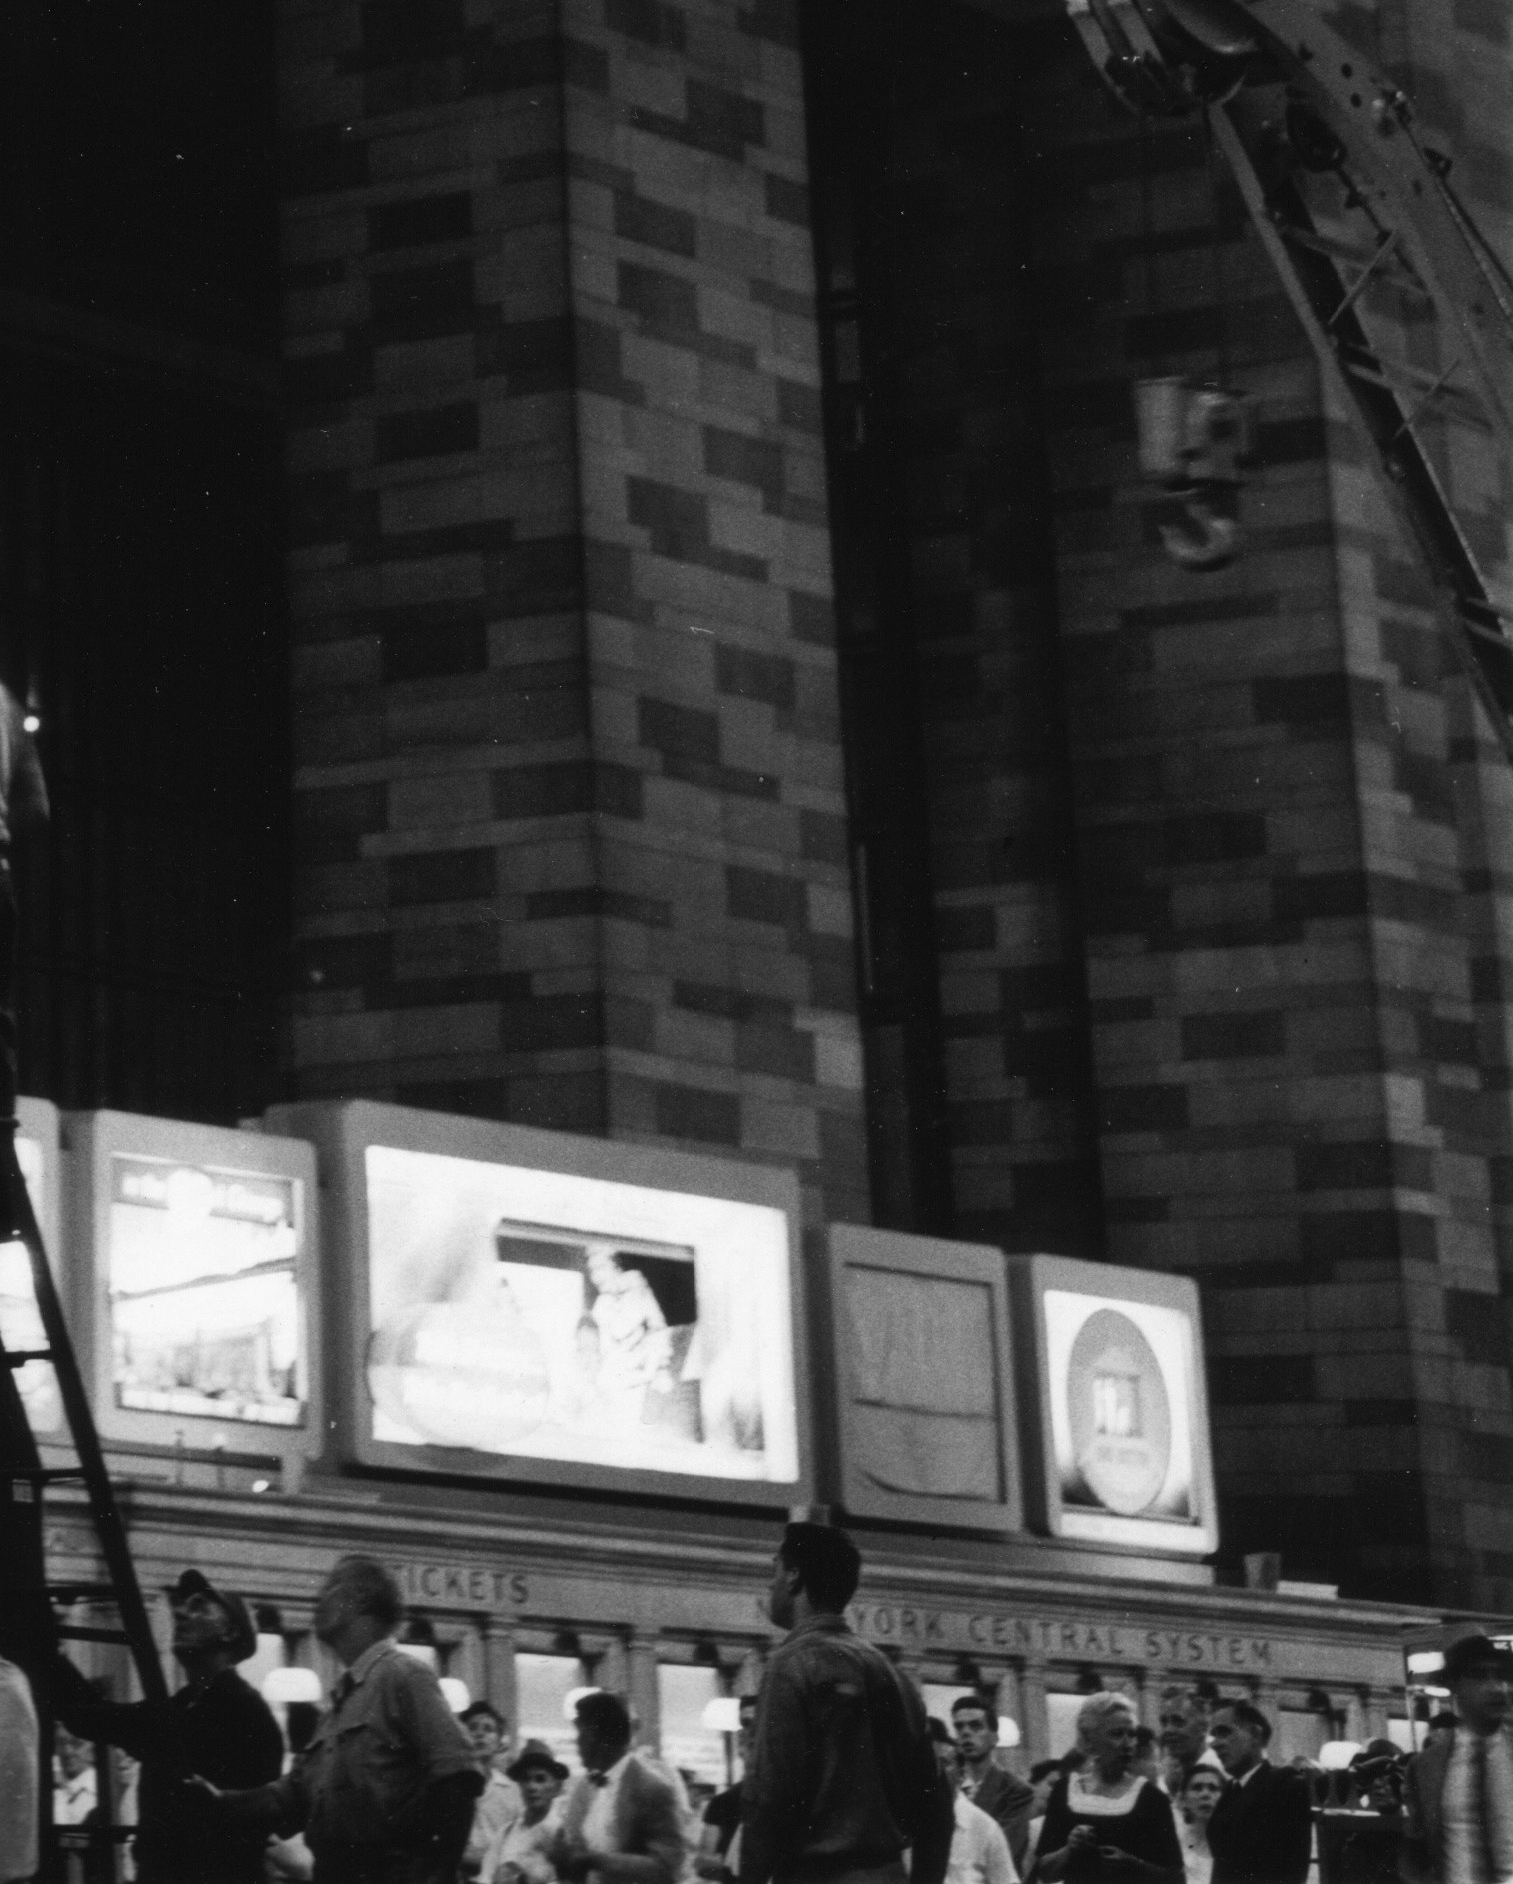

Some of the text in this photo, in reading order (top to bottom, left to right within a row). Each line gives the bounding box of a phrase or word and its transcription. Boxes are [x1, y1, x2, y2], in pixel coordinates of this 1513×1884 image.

[853, 1605, 1273, 1665] YORK CENTRAL SYSTEM
